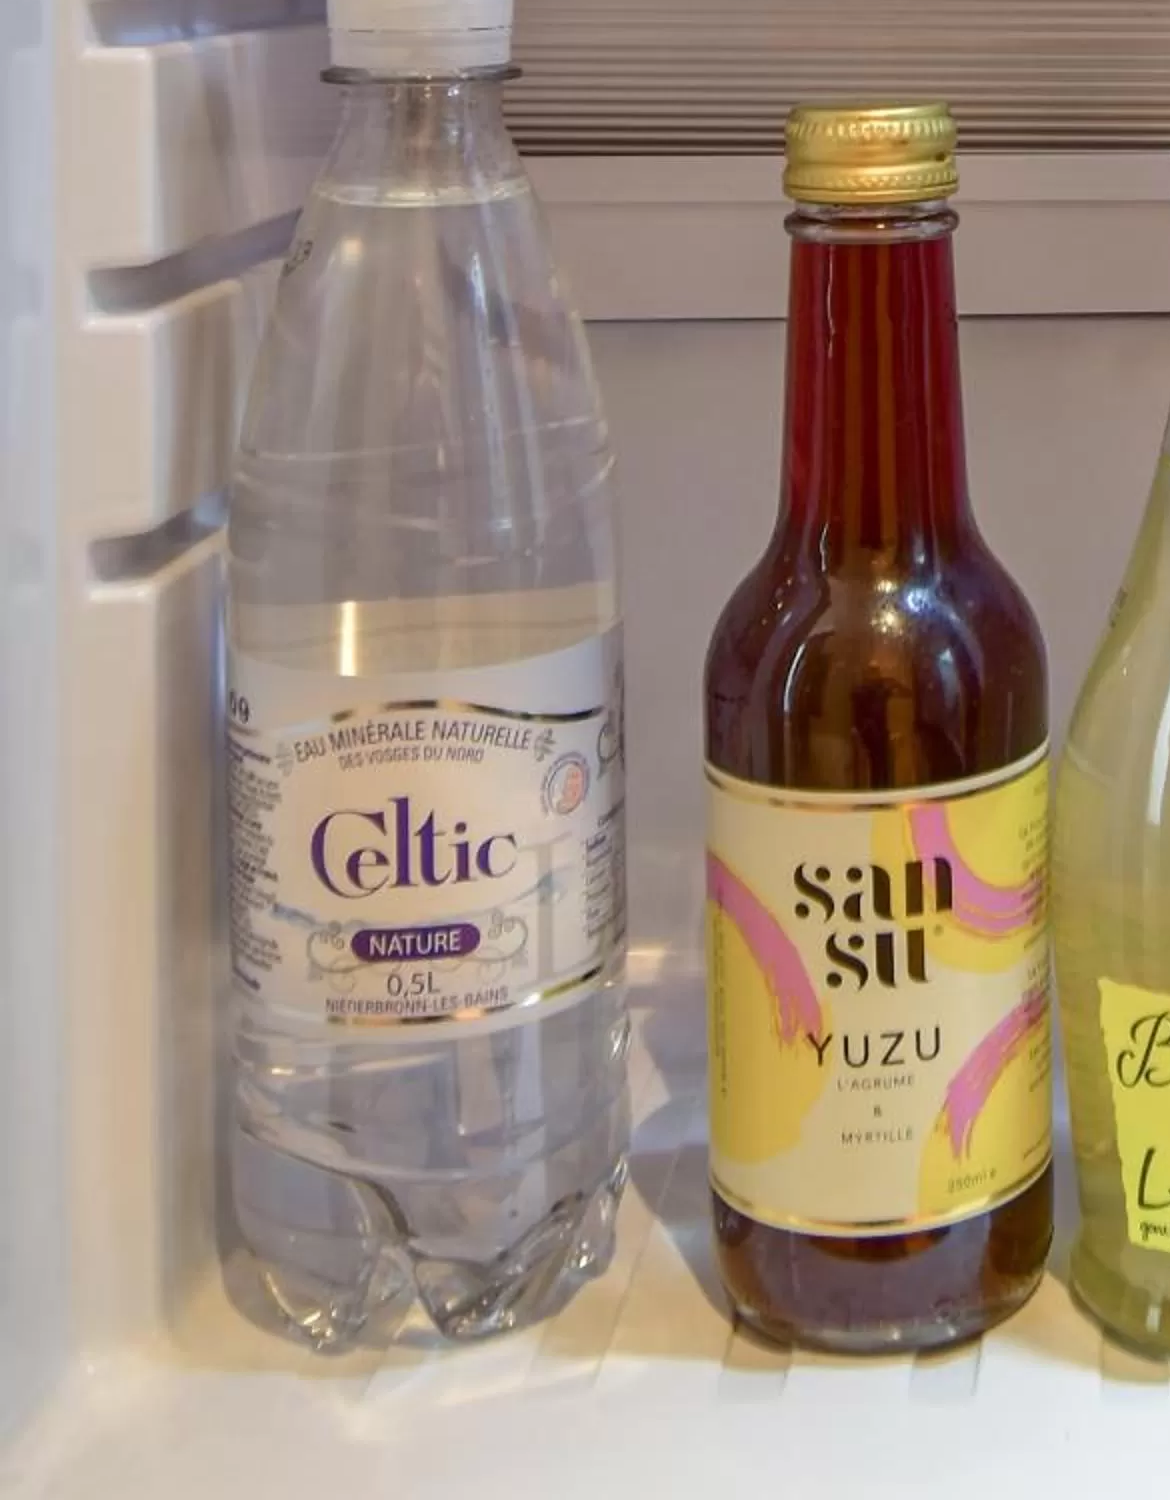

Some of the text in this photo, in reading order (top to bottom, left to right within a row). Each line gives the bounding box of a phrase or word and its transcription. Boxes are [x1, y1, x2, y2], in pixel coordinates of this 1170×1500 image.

[293, 718, 531, 764] EAU MINÉRALE NATURELLE
[338, 746, 485, 771] DES VOSGES DU NORD
[310, 796, 518, 900] Celtic
[793, 856, 954, 924] san
[368, 930, 462, 957] NATURE
[386, 970, 441, 1000] 0,5L
[807, 1025, 941, 1069] YUZU
[836, 1073, 915, 1093] L'AGRUME
[841, 1126, 914, 1146] MYRTILLE
